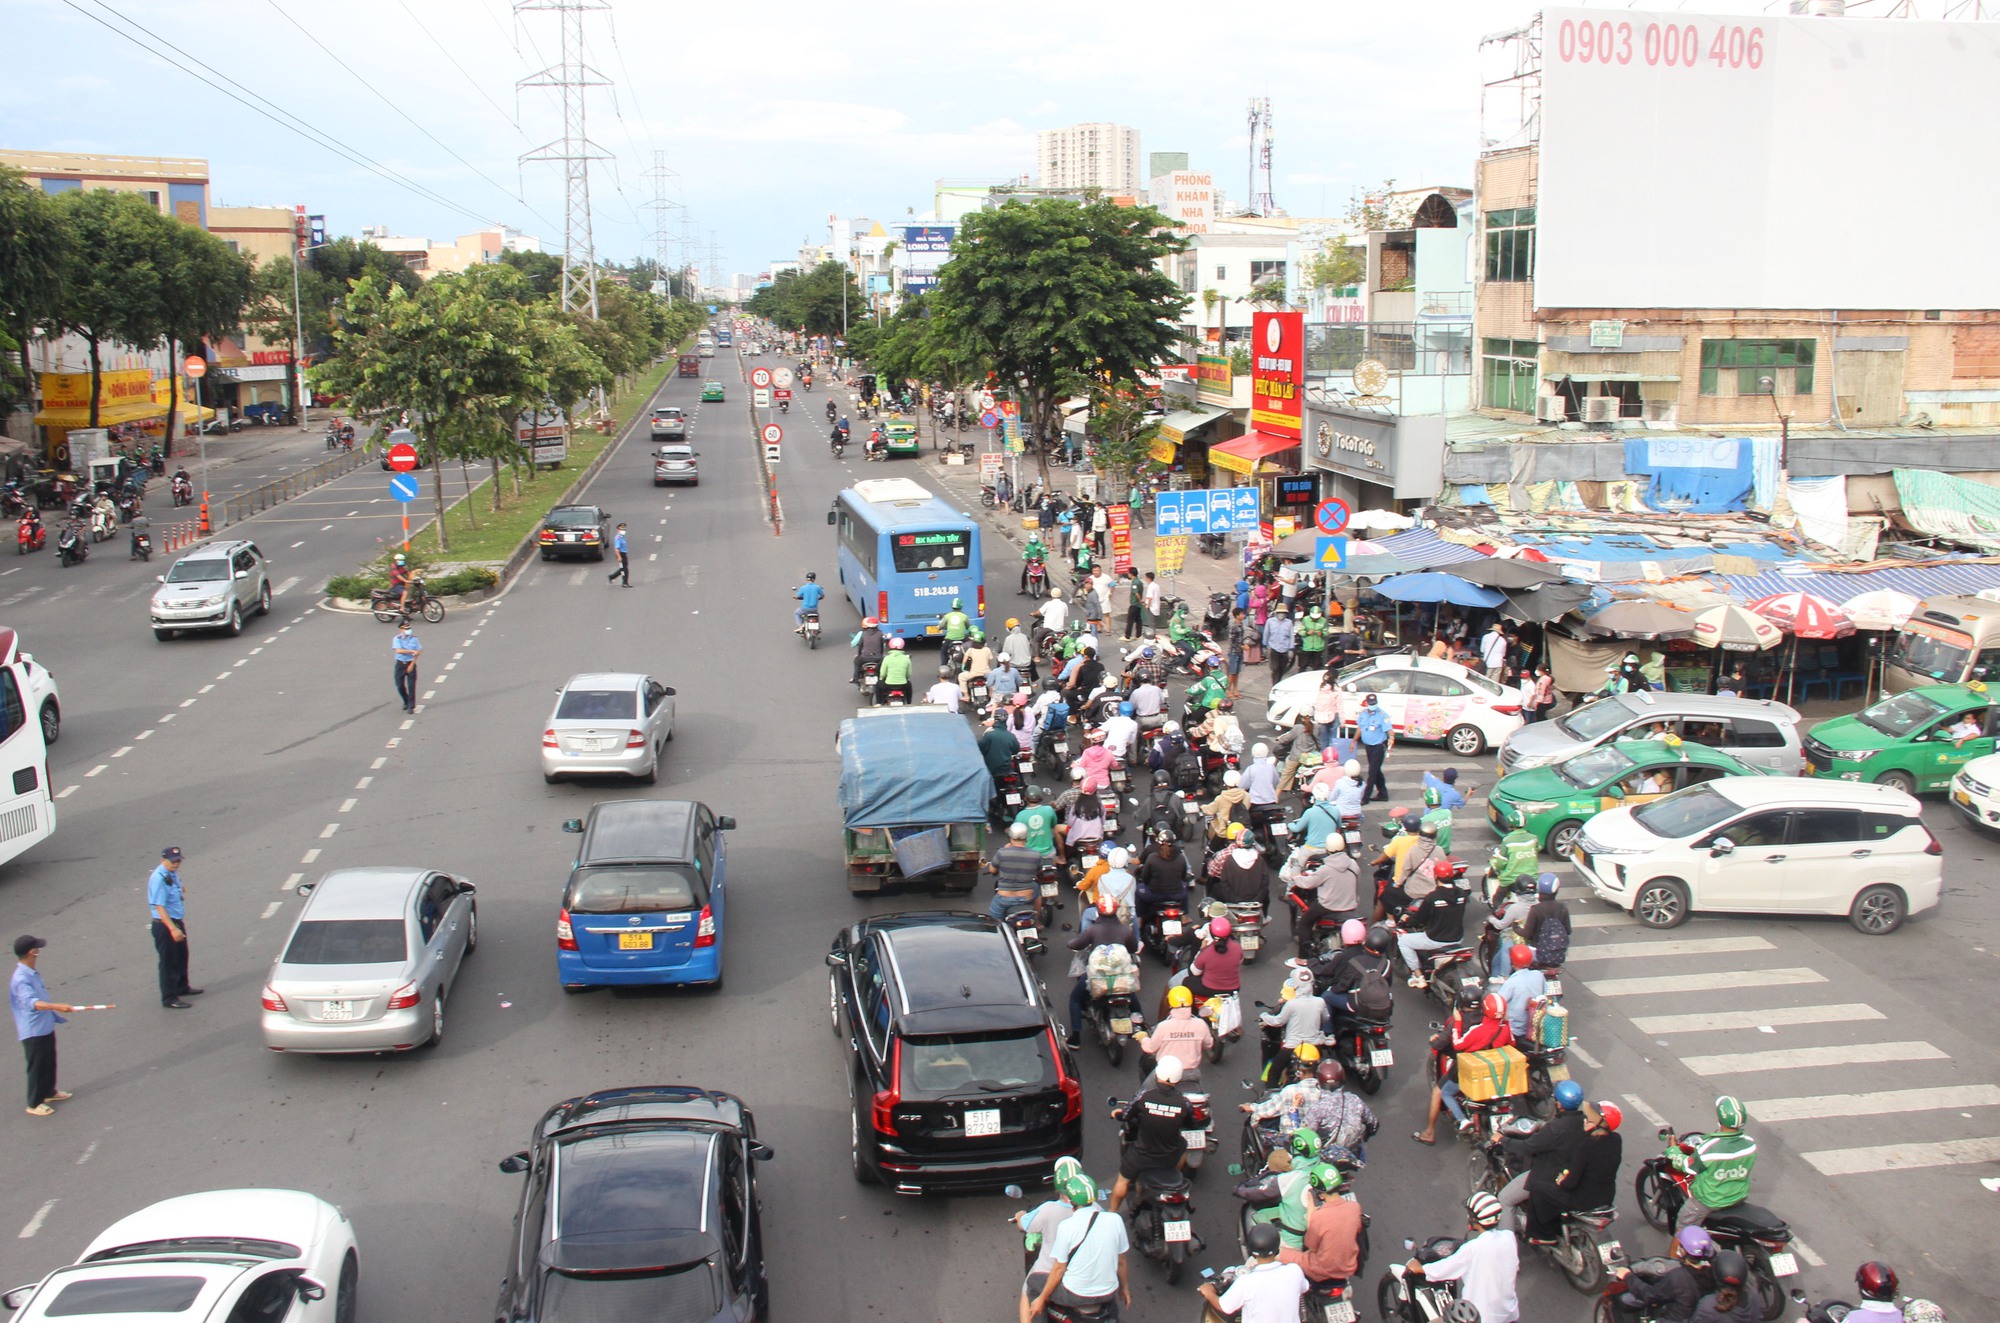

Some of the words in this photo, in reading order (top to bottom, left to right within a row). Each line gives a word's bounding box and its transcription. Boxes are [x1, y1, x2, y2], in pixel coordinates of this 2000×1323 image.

[1559, 19, 1633, 65] 0903
[1644, 23, 1699, 67] 000
[1708, 26, 1764, 70] 406
[1182, 207, 1203, 217] NHA
[1178, 223, 1207, 233] KHOA
[932, 241, 950, 250] CHÂ
[253, 351, 292, 365] MOTE
[756, 373, 767, 382] 70
[768, 429, 777, 438] 60
[899, 535, 915, 545] 32
[946, 533, 960, 542] TÂY
[1174, 537, 1187, 546] XE
[973, 1111, 991, 1121] 51F
[1713, 1167, 1748, 1181] Grab
